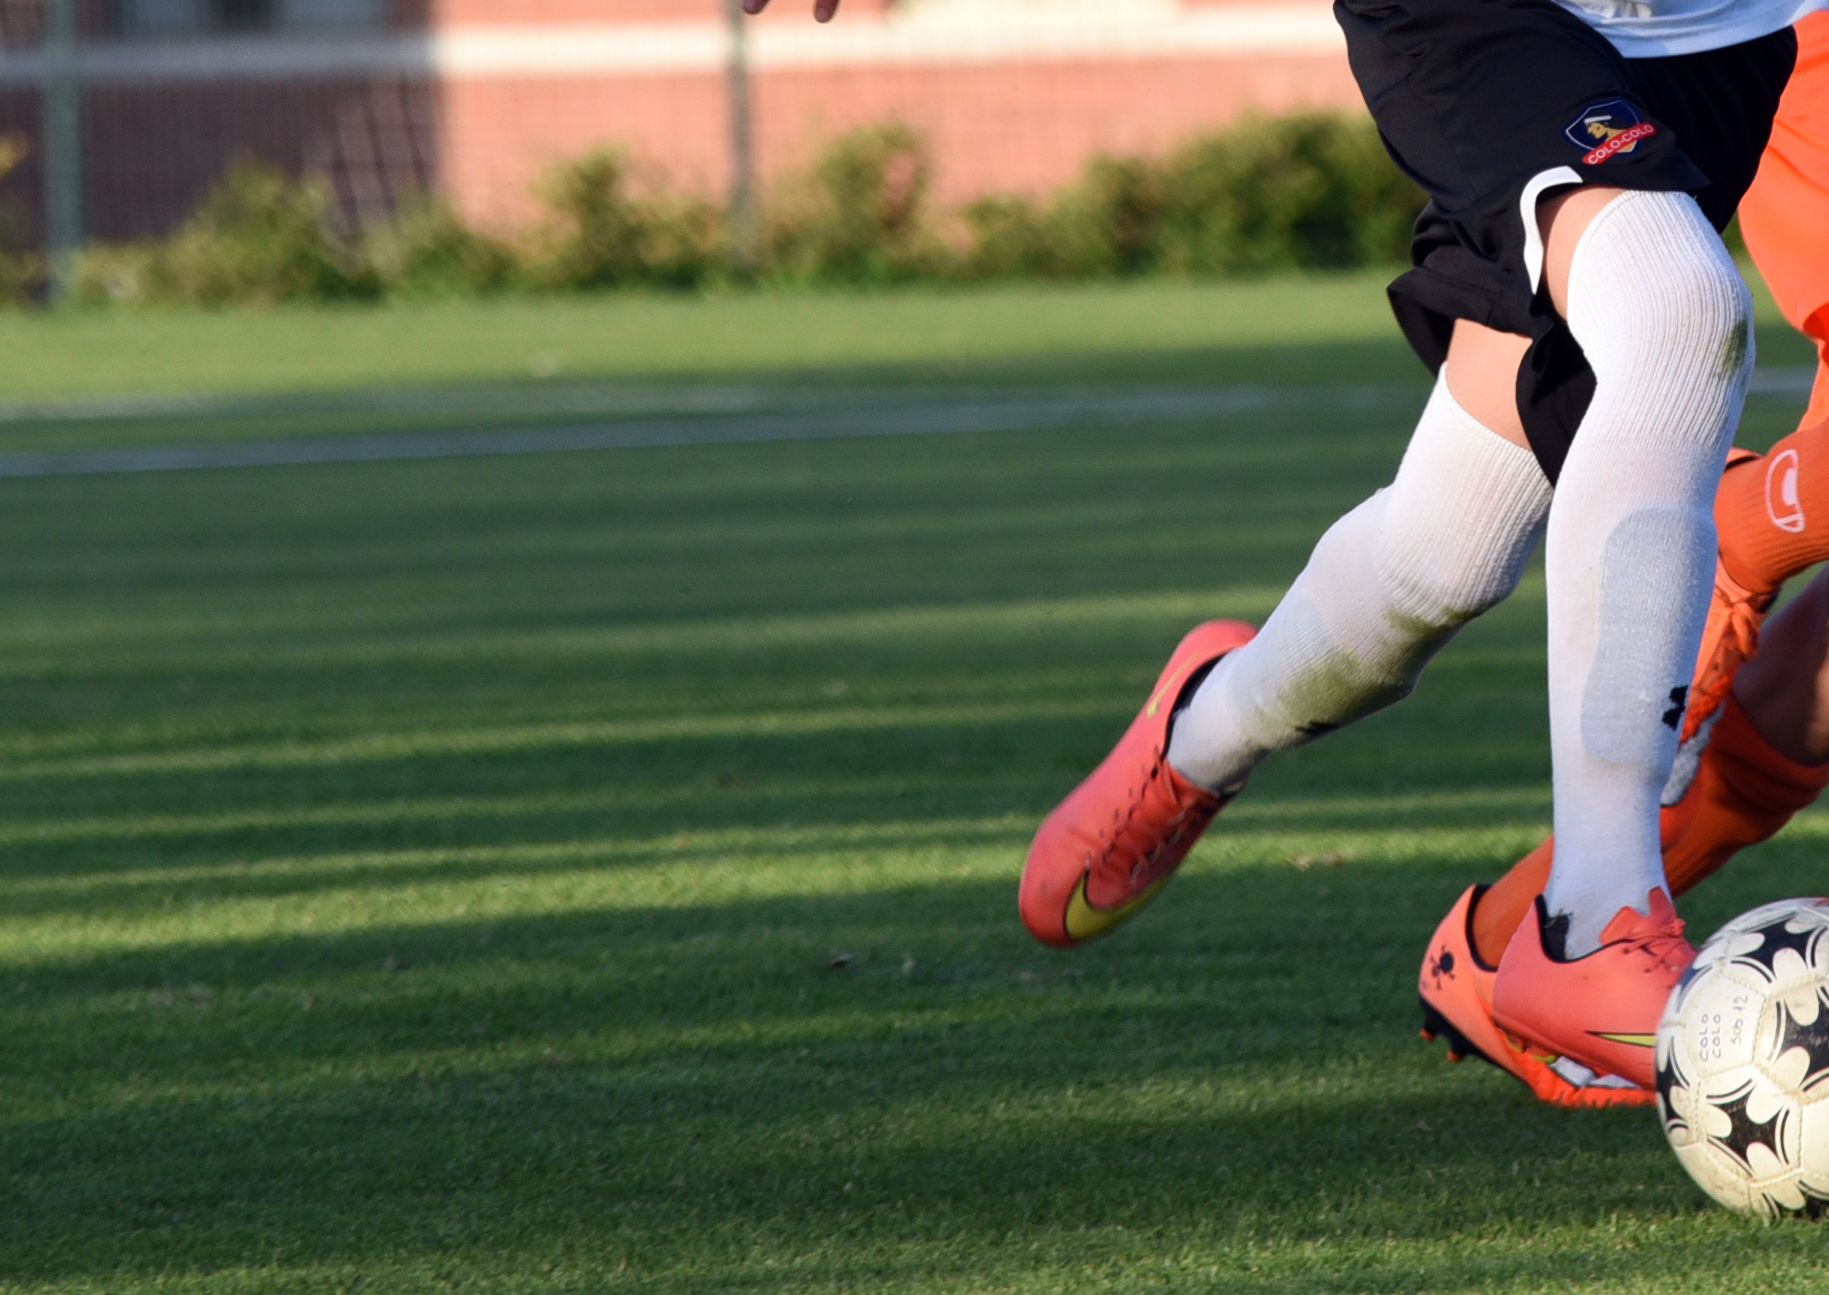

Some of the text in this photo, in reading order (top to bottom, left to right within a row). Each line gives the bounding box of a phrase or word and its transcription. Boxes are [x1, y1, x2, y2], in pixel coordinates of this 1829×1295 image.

[1588, 124, 1654, 165] COLO-COLO
[1699, 1013, 1709, 1062] COLO
[1711, 1014, 1721, 1059] COLO
